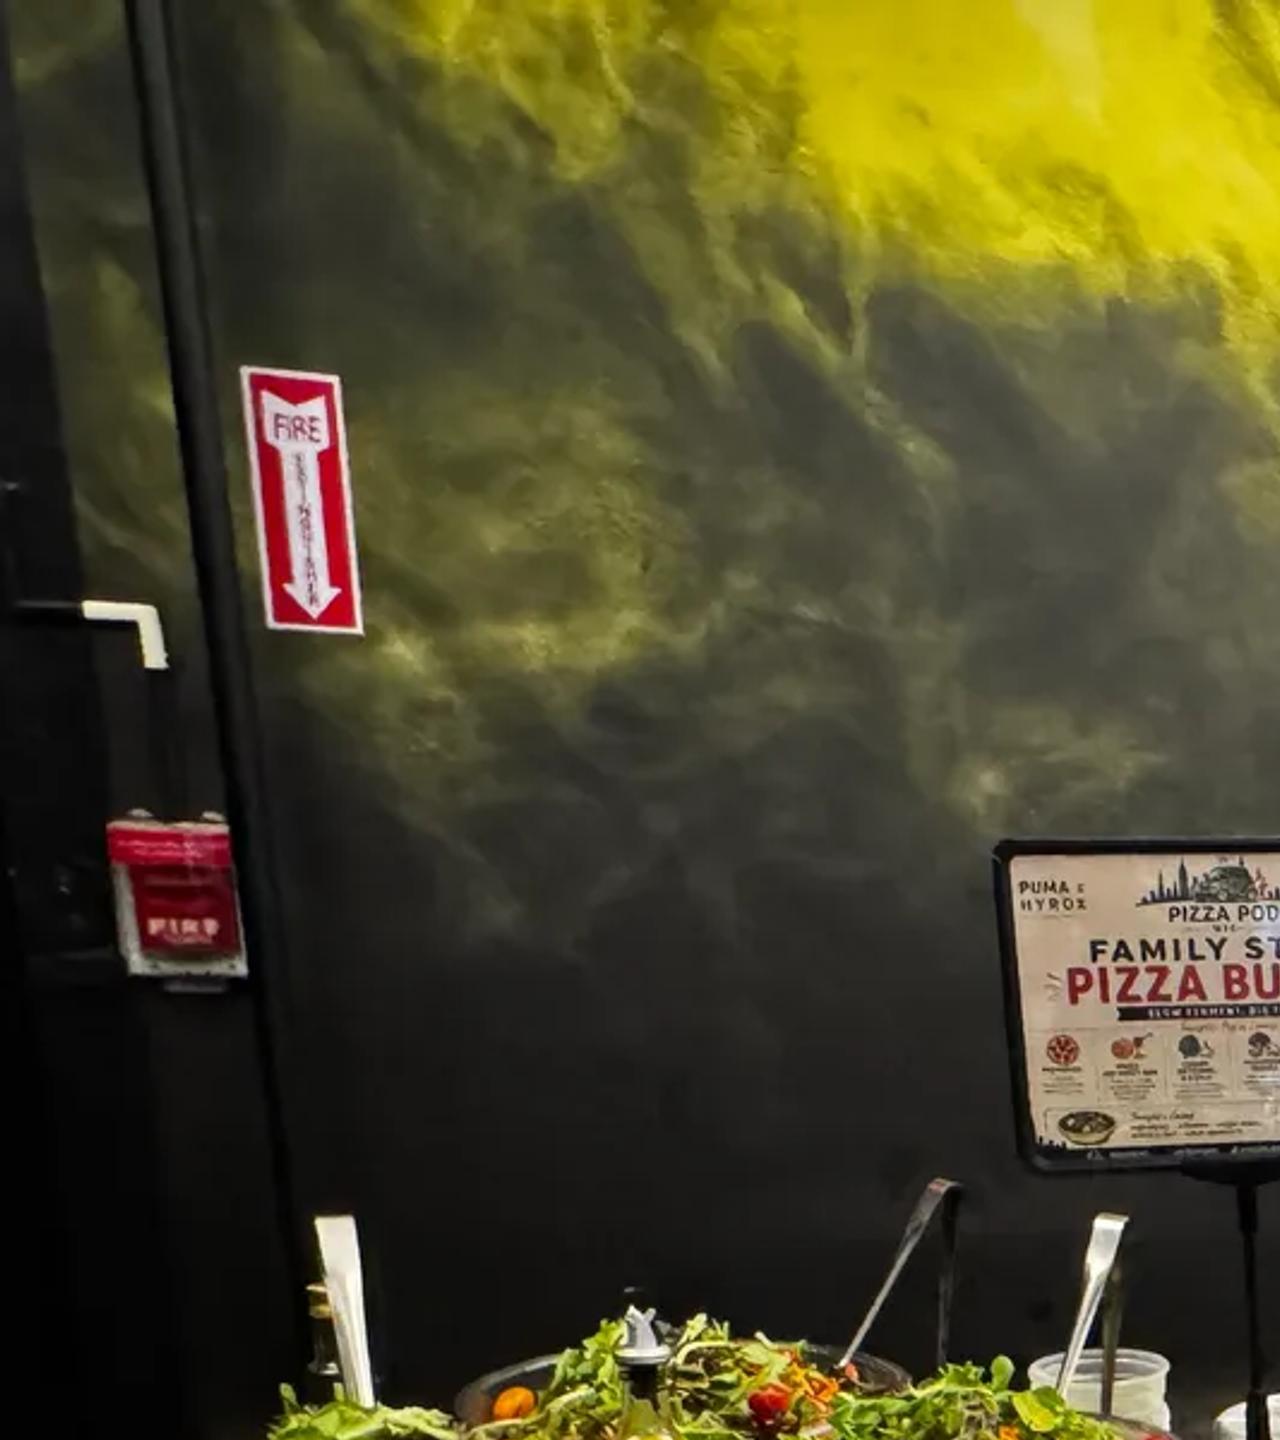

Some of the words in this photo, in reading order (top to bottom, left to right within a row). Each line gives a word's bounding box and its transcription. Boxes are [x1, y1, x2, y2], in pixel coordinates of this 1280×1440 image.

[273, 413, 321, 442] FIRE
[1018, 880, 1069, 894] PUMA
[1020, 897, 1087, 911] HYROX
[1168, 905, 1230, 922] PIZZA
[1238, 904, 1279, 921] POD
[1090, 936, 1228, 963] FAMILY
[1066, 964, 1207, 1006] PIZZA
